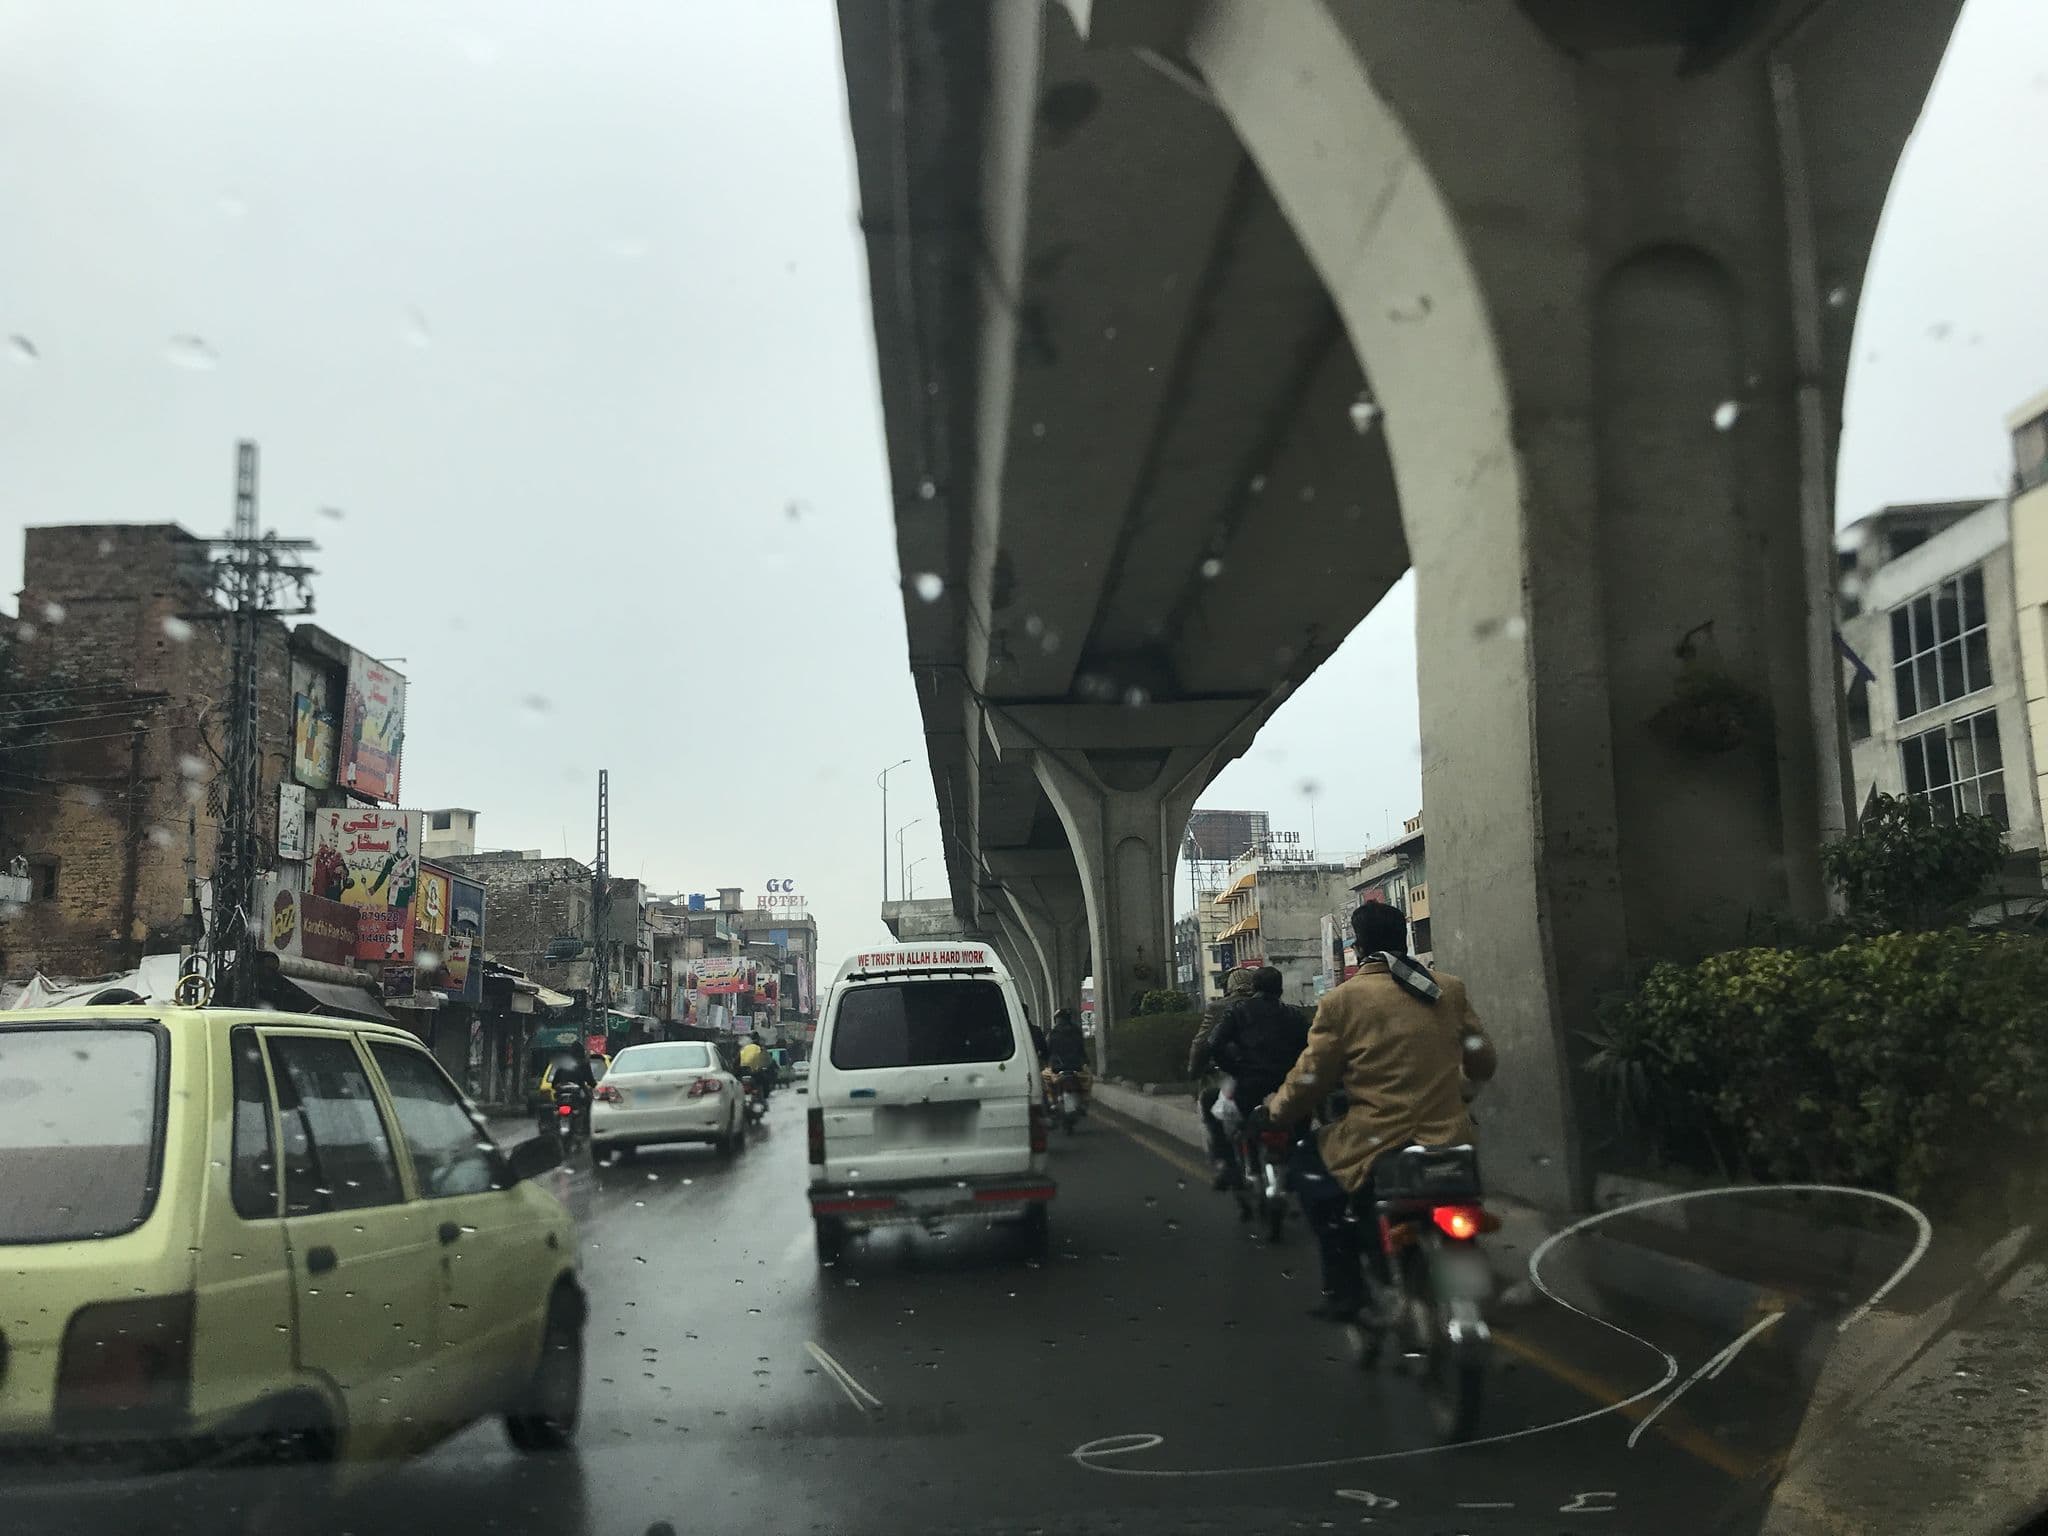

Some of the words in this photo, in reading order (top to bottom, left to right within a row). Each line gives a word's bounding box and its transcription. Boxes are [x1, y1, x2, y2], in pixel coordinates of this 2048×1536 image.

[757, 895, 808, 907] HOTEL
[858, 954, 870, 967] WE
[871, 953, 895, 966] TRUST
[897, 952, 905, 965] IN
[906, 951, 931, 965] ALLAH
[933, 951, 938, 963] &
[940, 950, 960, 964] HARD
[962, 950, 984, 964] WORK
